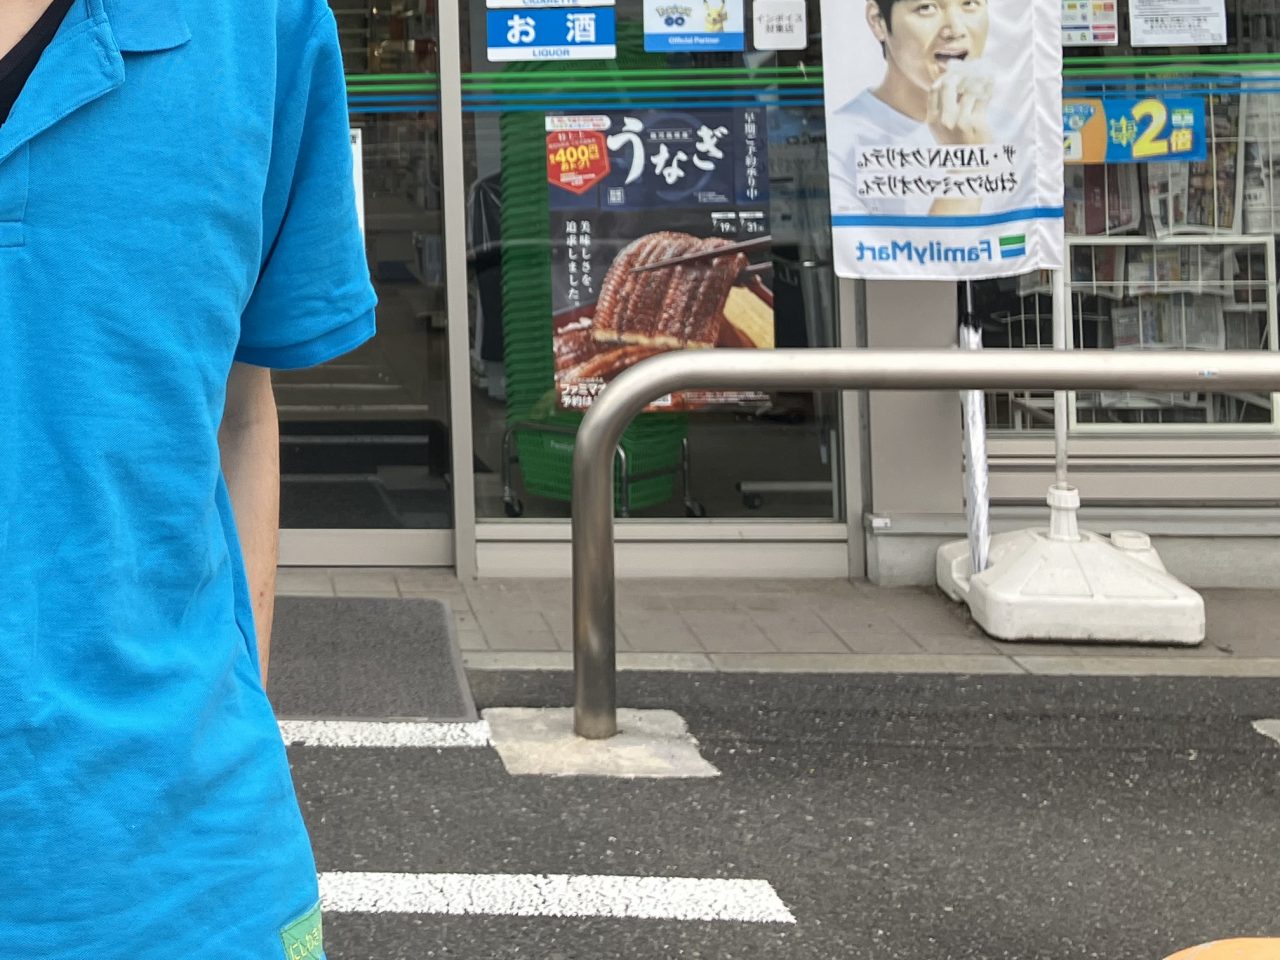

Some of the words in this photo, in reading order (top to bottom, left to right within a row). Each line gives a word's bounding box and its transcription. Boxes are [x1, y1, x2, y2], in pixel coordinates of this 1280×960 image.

[757, 13, 803, 24] インボイス
[694, 35, 720, 44] Partner
[532, 48, 570, 57] LIQUOR
[606, 116, 730, 186] うなぎ
